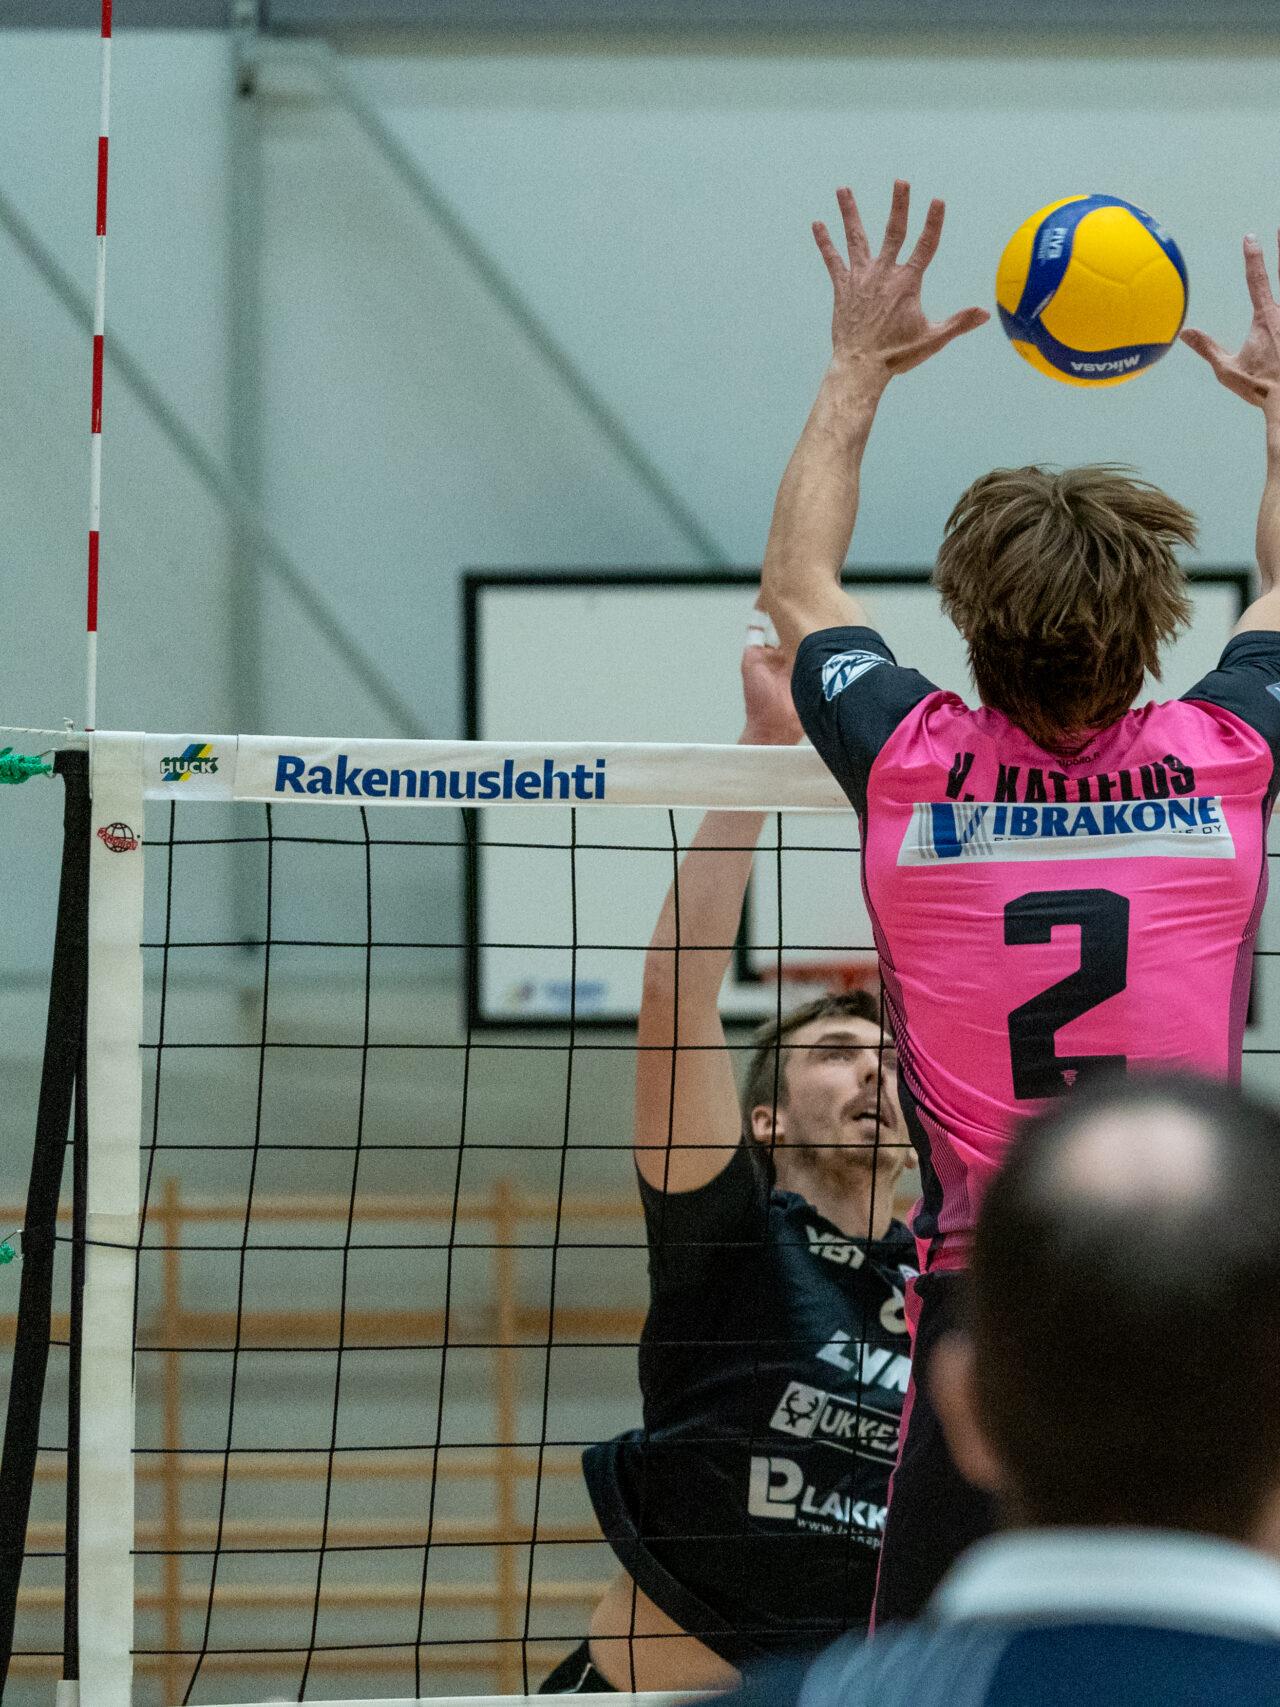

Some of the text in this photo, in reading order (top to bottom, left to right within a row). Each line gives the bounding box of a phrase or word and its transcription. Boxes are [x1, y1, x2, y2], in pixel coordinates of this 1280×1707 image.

[160, 757, 218, 775] HUCK
[275, 753, 606, 800] Rakennuslehti
[1003, 887, 1131, 1100] 2
